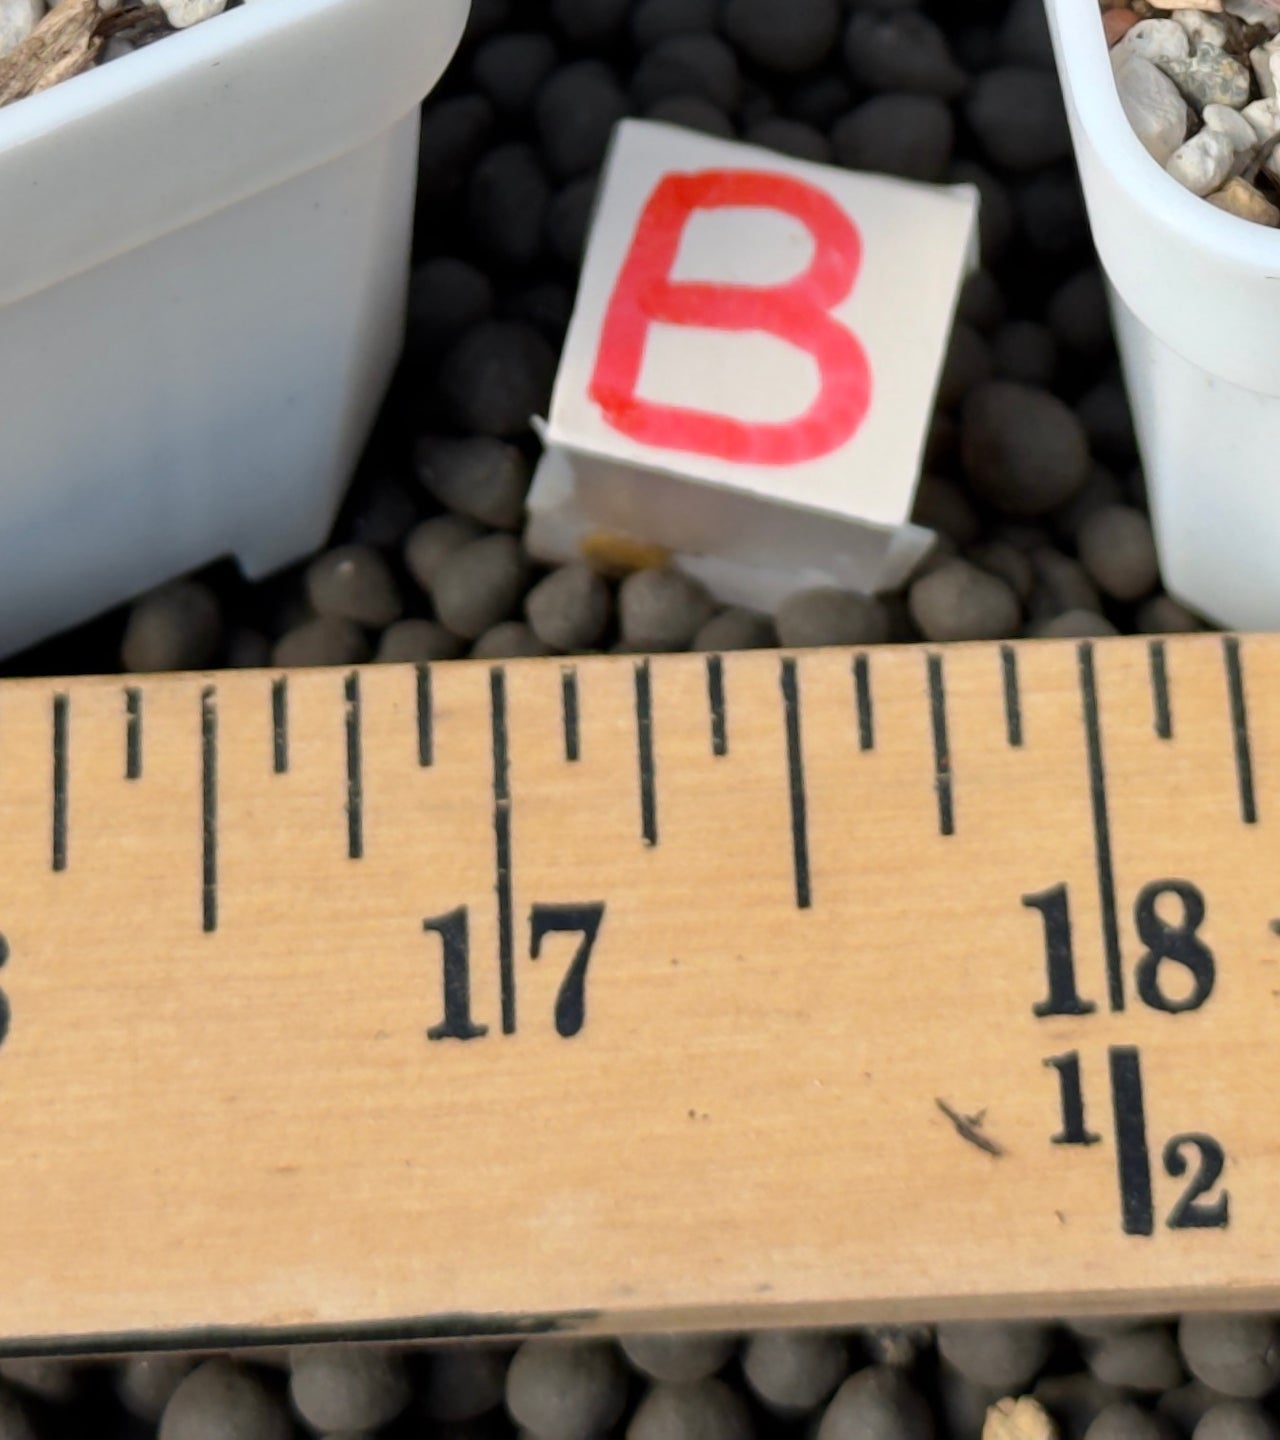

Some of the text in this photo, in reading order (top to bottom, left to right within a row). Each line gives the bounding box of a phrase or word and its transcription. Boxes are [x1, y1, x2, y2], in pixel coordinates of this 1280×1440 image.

[587, 168, 873, 468] B
[420, 900, 607, 1042] 17
[1021, 879, 1217, 1019] 18
